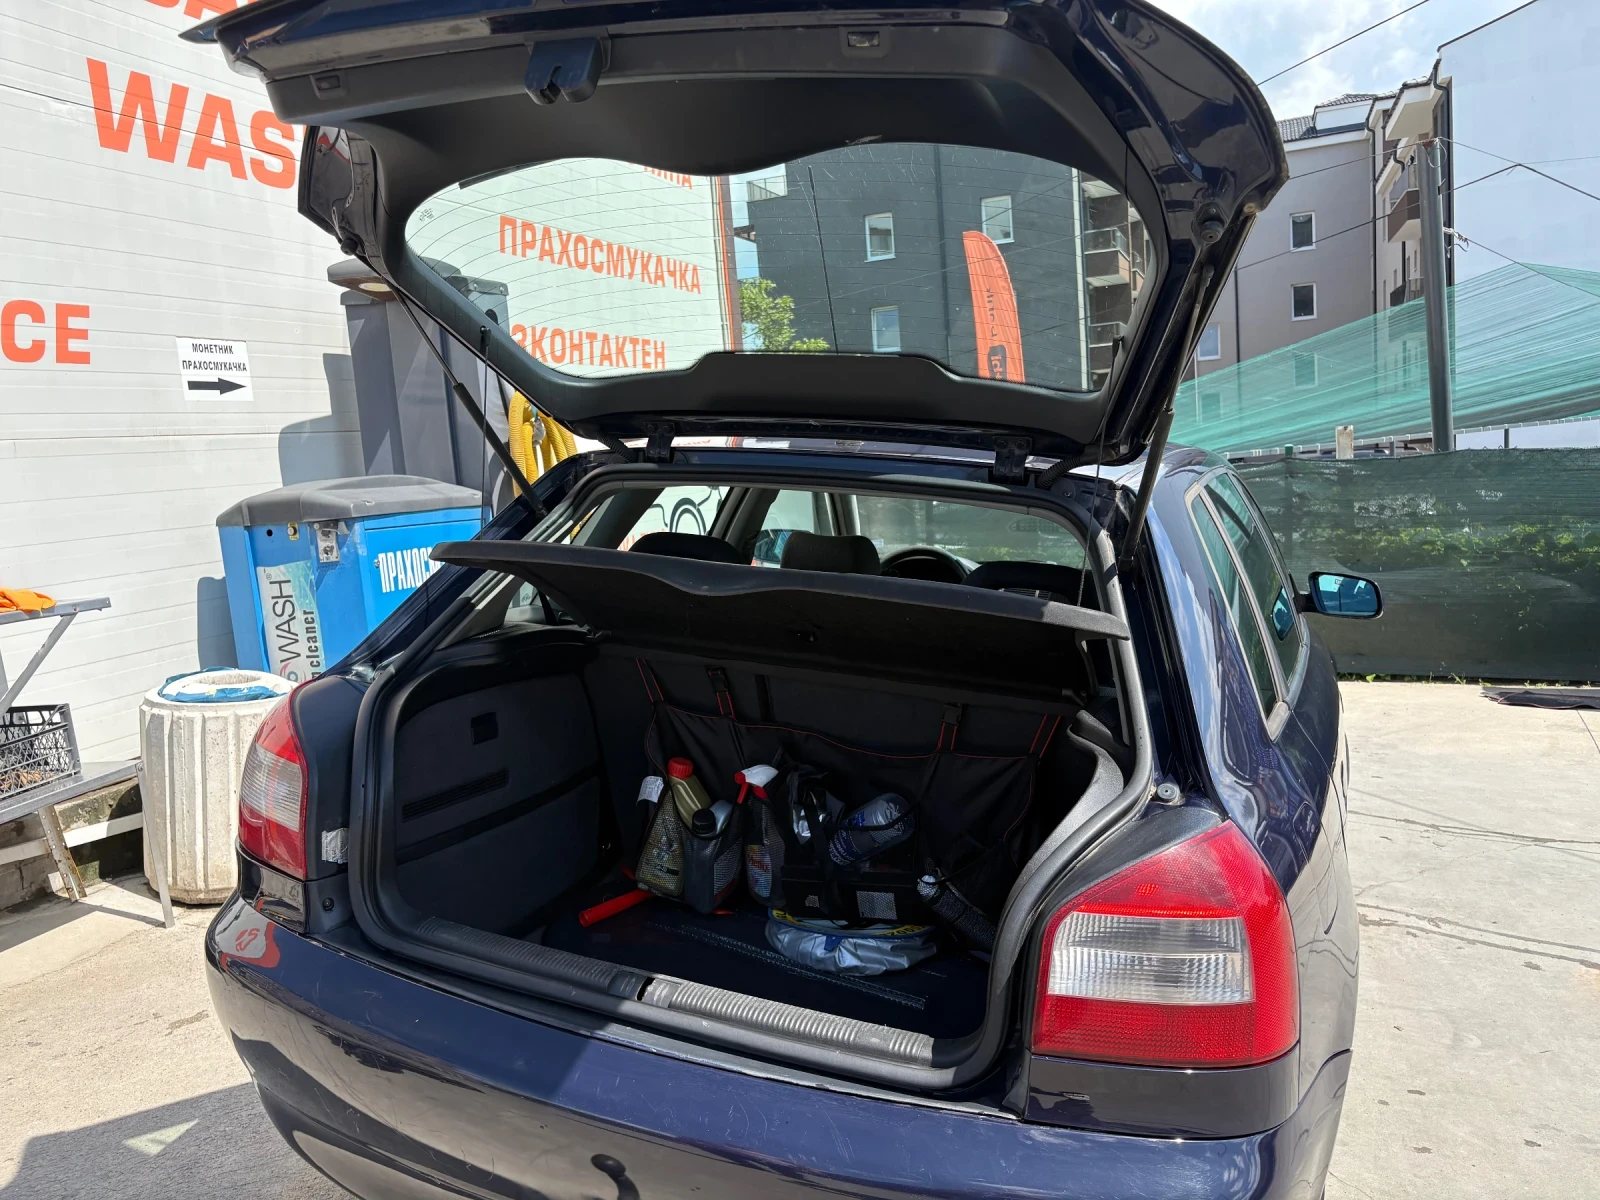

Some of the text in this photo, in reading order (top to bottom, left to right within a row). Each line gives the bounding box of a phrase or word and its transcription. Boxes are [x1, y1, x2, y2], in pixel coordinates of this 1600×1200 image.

[86, 57, 306, 190] WAS
[499, 214, 702, 294] ПРАХОСМУКАЧКА
[182, 359, 248, 373] ПРАХОСМУКАЧКА
[191, 342, 234, 355] МОНЕТНИК
